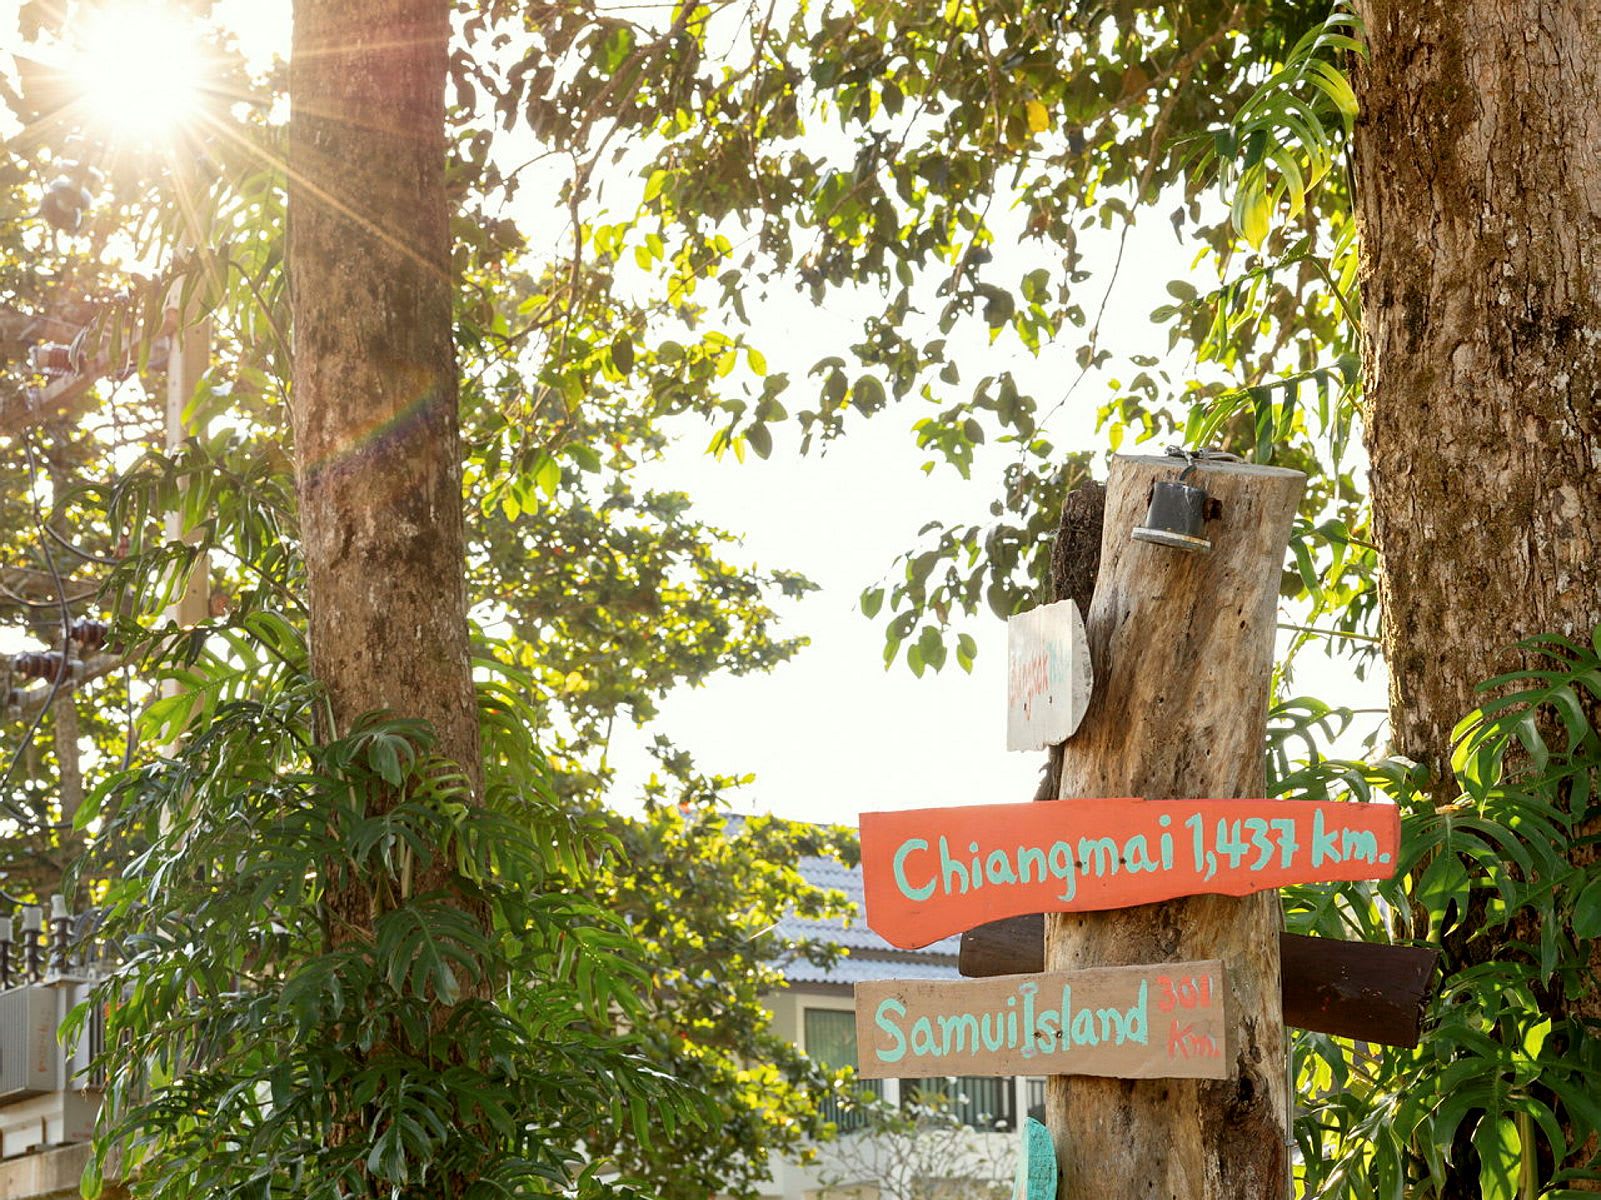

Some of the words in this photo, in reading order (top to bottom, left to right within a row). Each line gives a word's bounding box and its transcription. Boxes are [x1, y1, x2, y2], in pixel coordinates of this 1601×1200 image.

[893, 814, 1175, 902] Chiangmai
[1185, 812, 1300, 882] 1,437
[1313, 808, 1391, 869] km.
[1156, 972, 1213, 1014] 301
